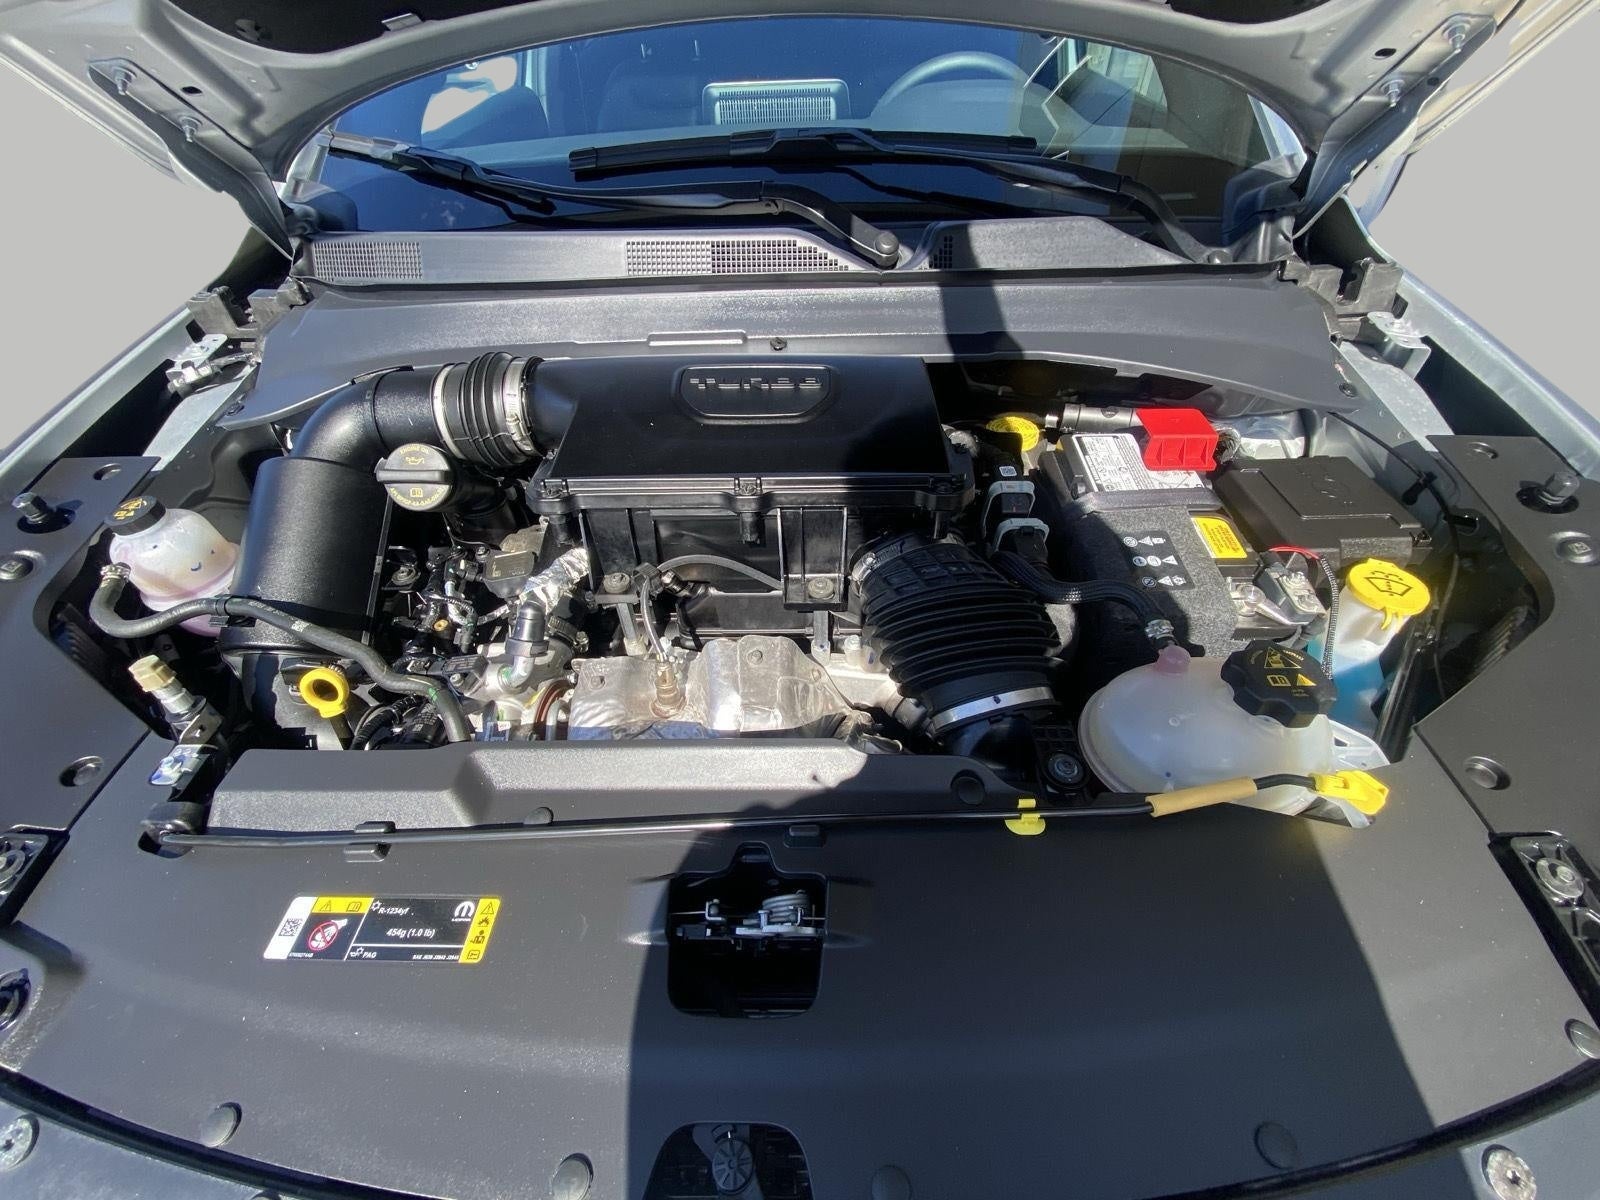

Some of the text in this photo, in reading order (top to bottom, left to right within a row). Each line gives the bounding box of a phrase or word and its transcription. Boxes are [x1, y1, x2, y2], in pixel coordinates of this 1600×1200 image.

[378, 907, 410, 915] R-1234yf
[386, 928, 436, 939] 454g (1.0 lb)
[362, 951, 377, 959] PAG
